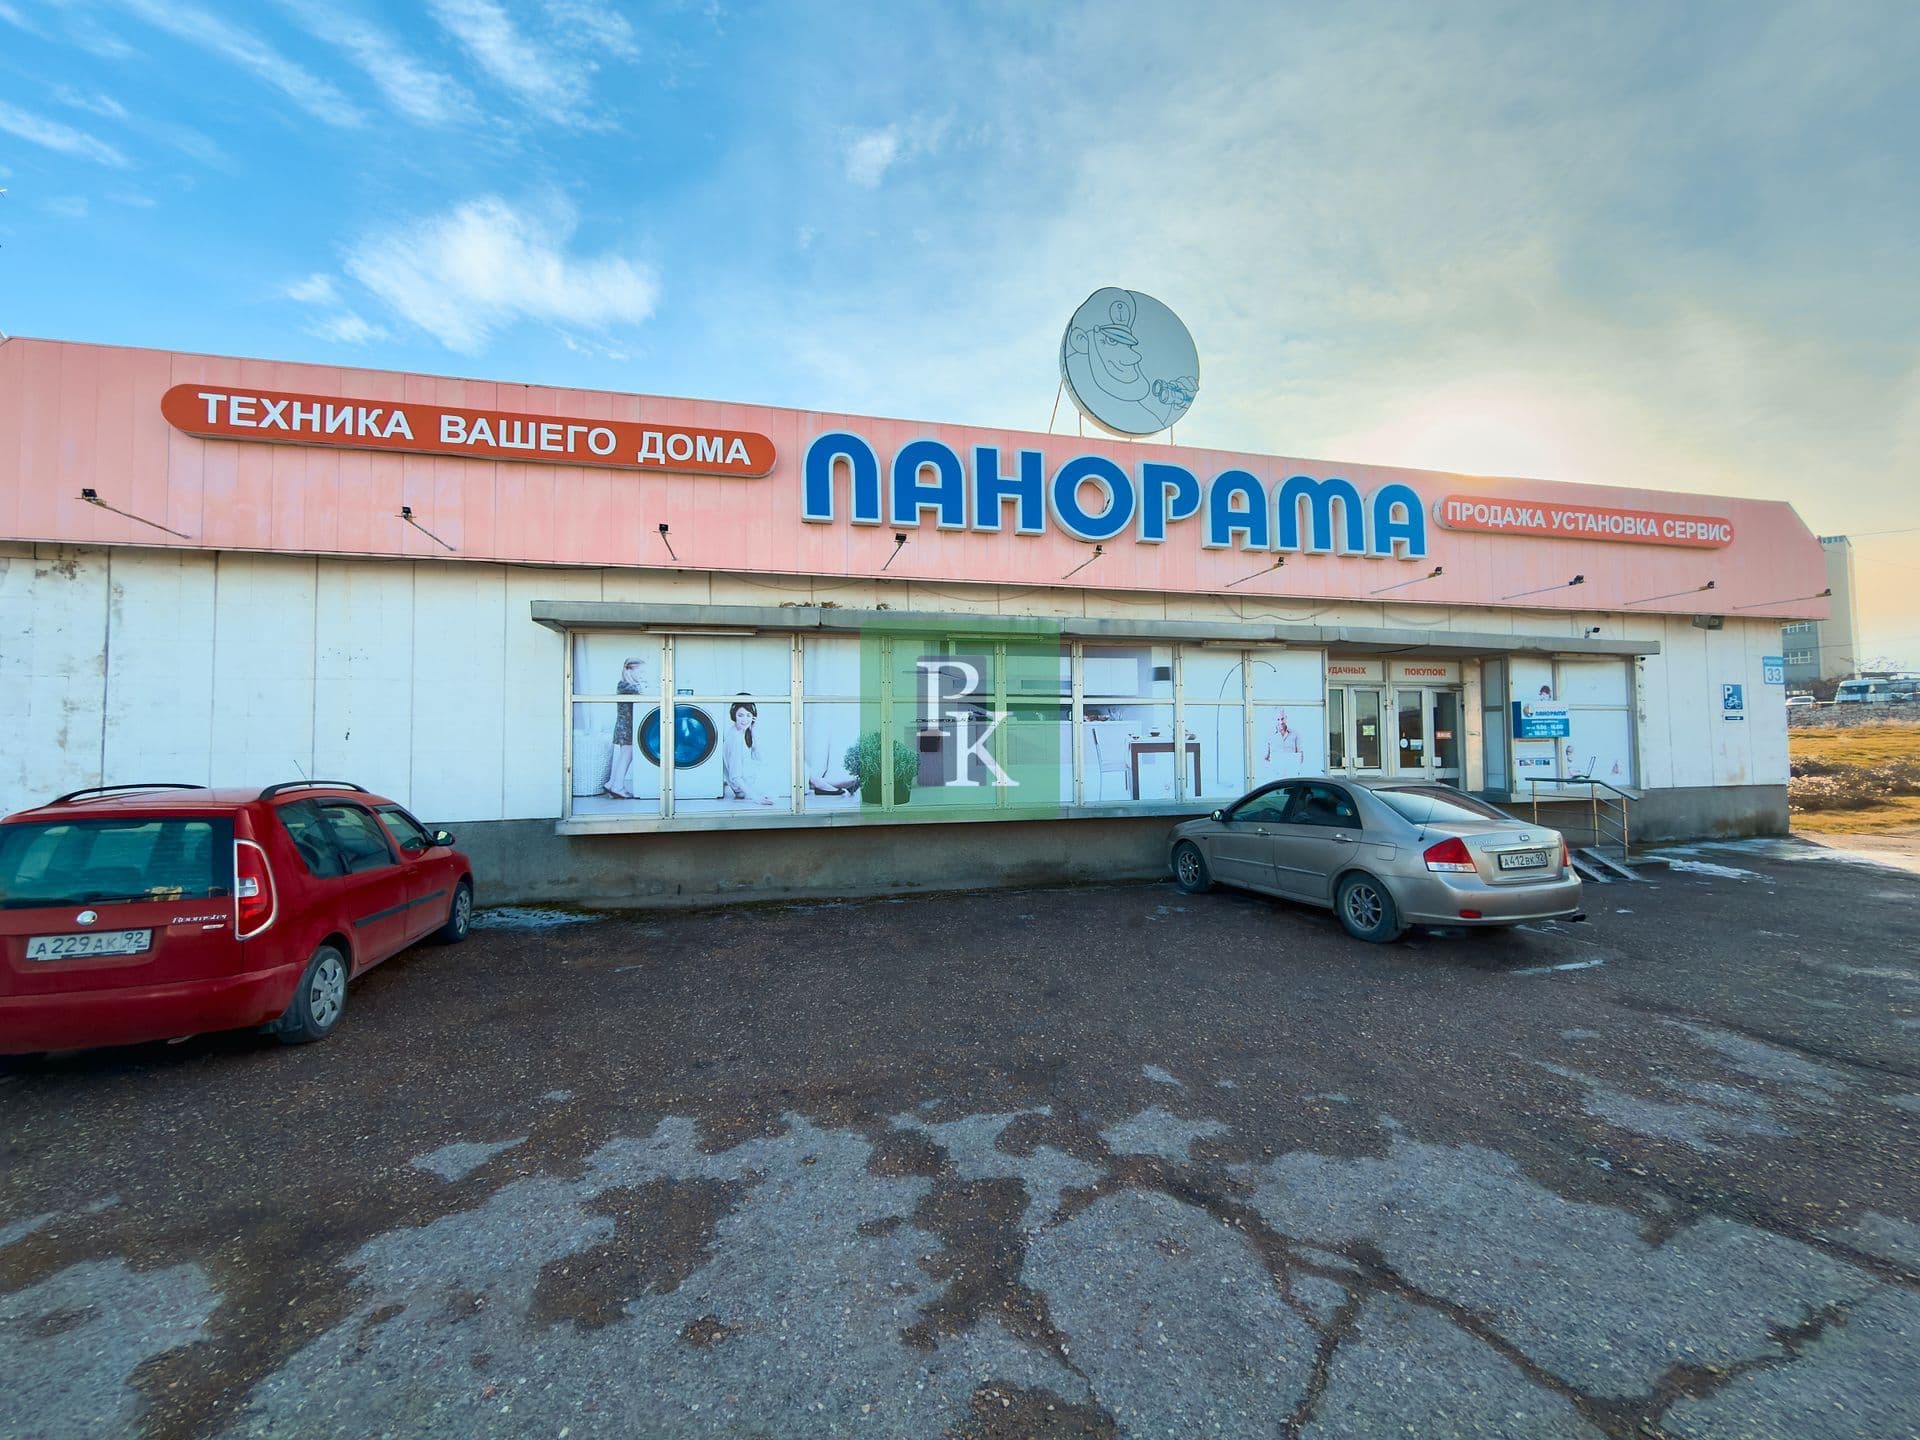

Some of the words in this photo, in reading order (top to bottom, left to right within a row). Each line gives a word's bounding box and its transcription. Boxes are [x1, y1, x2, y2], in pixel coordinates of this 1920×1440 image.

[197, 391, 415, 440] ТЕХНИКА
[438, 413, 618, 457] ВАШЕГО
[636, 430, 752, 467] ДОМА
[800, 429, 1429, 562] ПАНОРАМА
[1446, 500, 1547, 528] ПРОДАЖА
[1551, 509, 1659, 537] УСТАНОВКА
[1662, 518, 1732, 542] СЕРВИС
[1327, 666, 1367, 676] УДАЧНЫХ
[1404, 667, 1447, 677] ПОКУПОК!
[1767, 668, 1781, 681] 33
[1724, 685, 1732, 699] P
